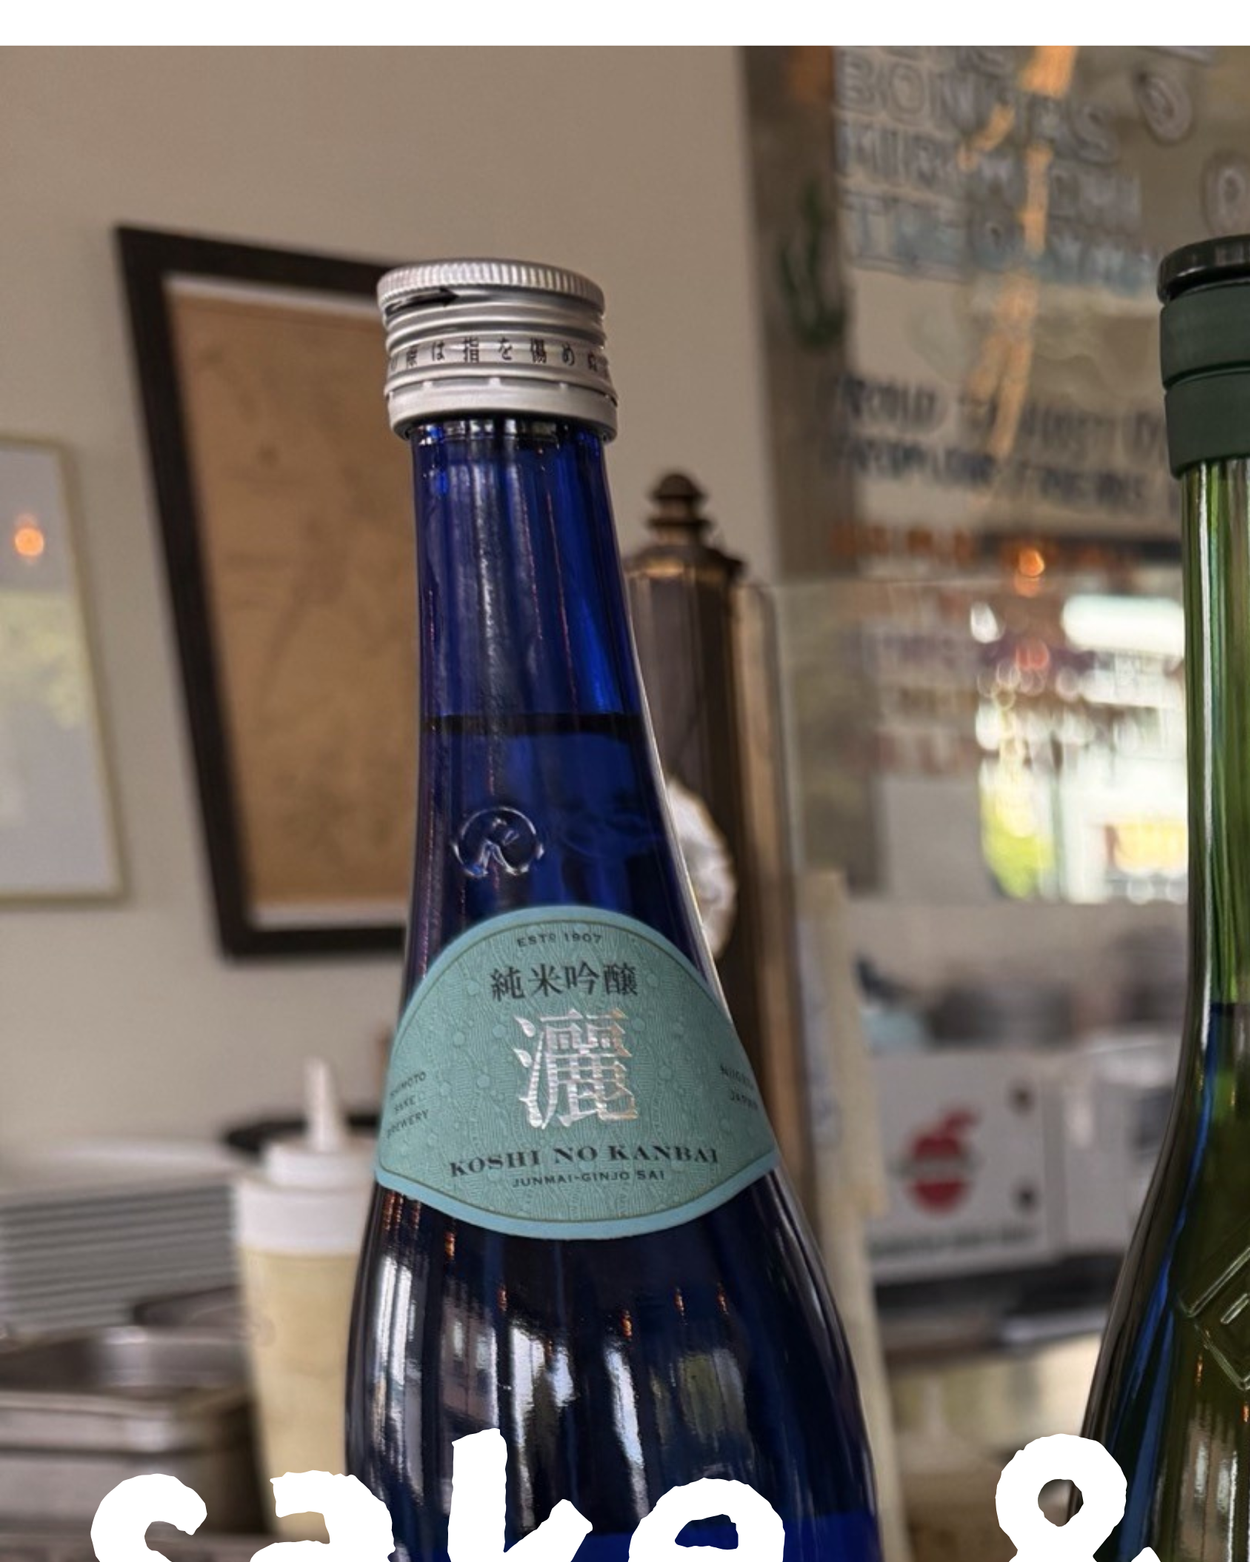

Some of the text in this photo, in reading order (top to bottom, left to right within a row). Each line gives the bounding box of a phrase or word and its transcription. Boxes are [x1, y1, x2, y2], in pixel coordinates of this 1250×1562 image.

[565, 932, 602, 944] 1907
[490, 961, 638, 1001] 純米吟醸
[450, 1144, 719, 1178] KOSHI NO KANBAI
[512, 1169, 665, 1188] JUNMAI-GINJO SAI
